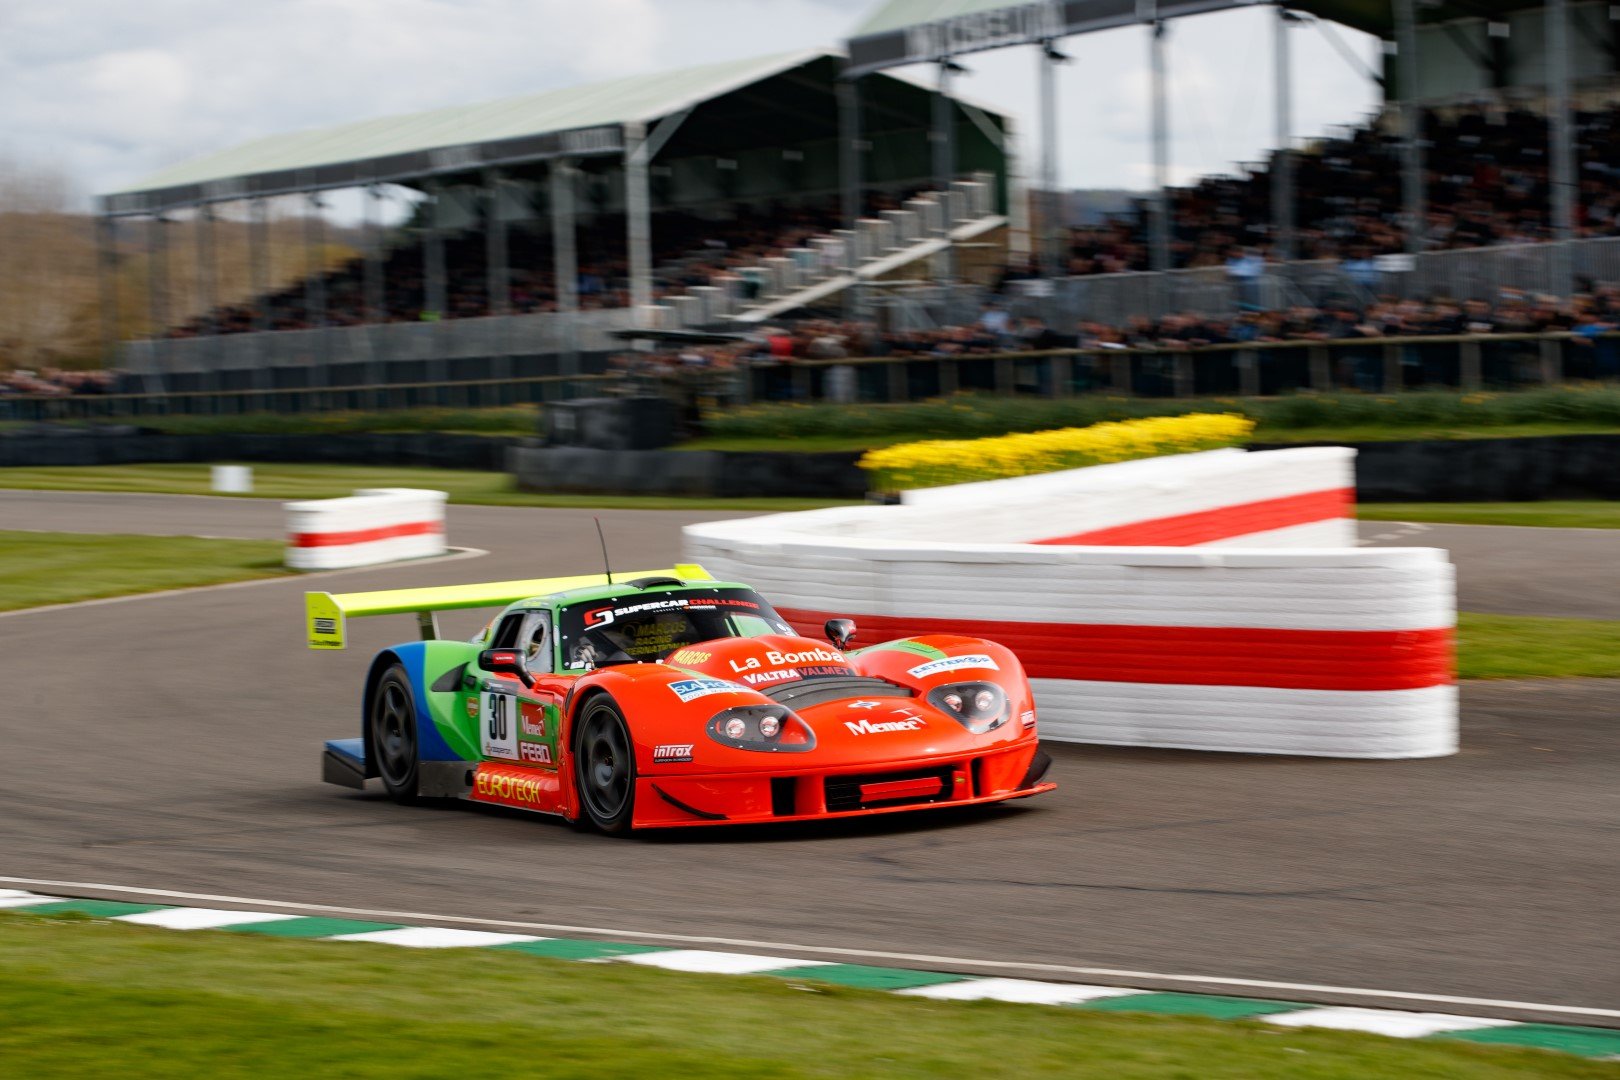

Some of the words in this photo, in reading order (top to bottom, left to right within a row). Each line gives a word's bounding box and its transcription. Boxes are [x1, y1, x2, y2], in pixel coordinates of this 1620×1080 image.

[614, 599, 689, 616] SUPERCAR
[689, 599, 760, 610] CHALLENGE
[673, 650, 712, 665] MARCOS
[729, 657, 761, 673] La
[766, 648, 845, 665] Bomba
[743, 668, 800, 685] VALTRA
[798, 666, 850, 676] VALMET
[489, 693, 507, 740] 30
[520, 741, 551, 763] FEBO
[653, 744, 695, 758] inTrax
[477, 772, 541, 804] EUROTECH
